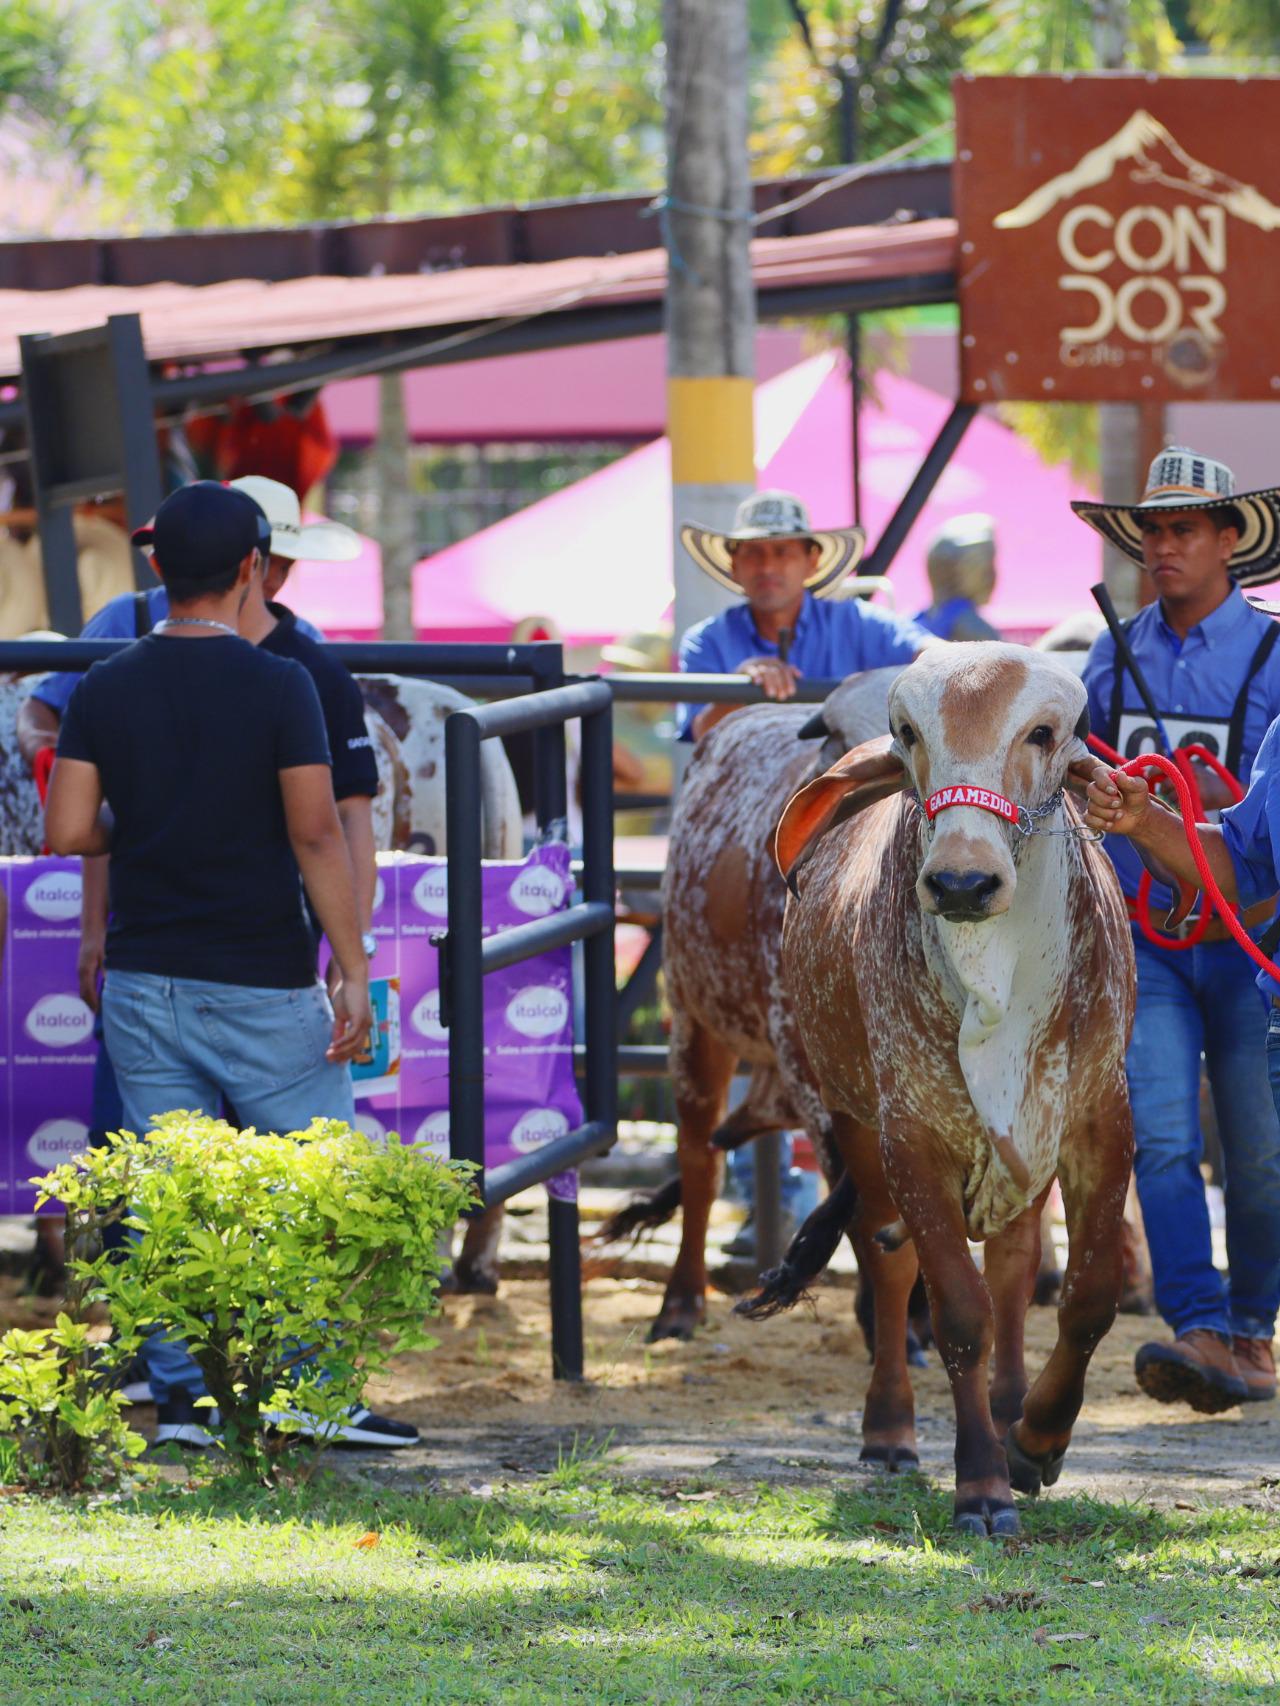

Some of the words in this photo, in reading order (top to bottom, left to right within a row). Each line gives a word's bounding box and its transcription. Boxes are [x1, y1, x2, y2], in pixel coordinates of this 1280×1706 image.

[1057, 204, 1227, 274] CON
[1058, 274, 1227, 343] DOR
[930, 788, 1012, 817] GANAMEDIO
[35, 887, 82, 901] italco
[36, 1012, 86, 1027] italcol
[515, 1002, 563, 1019] italcol
